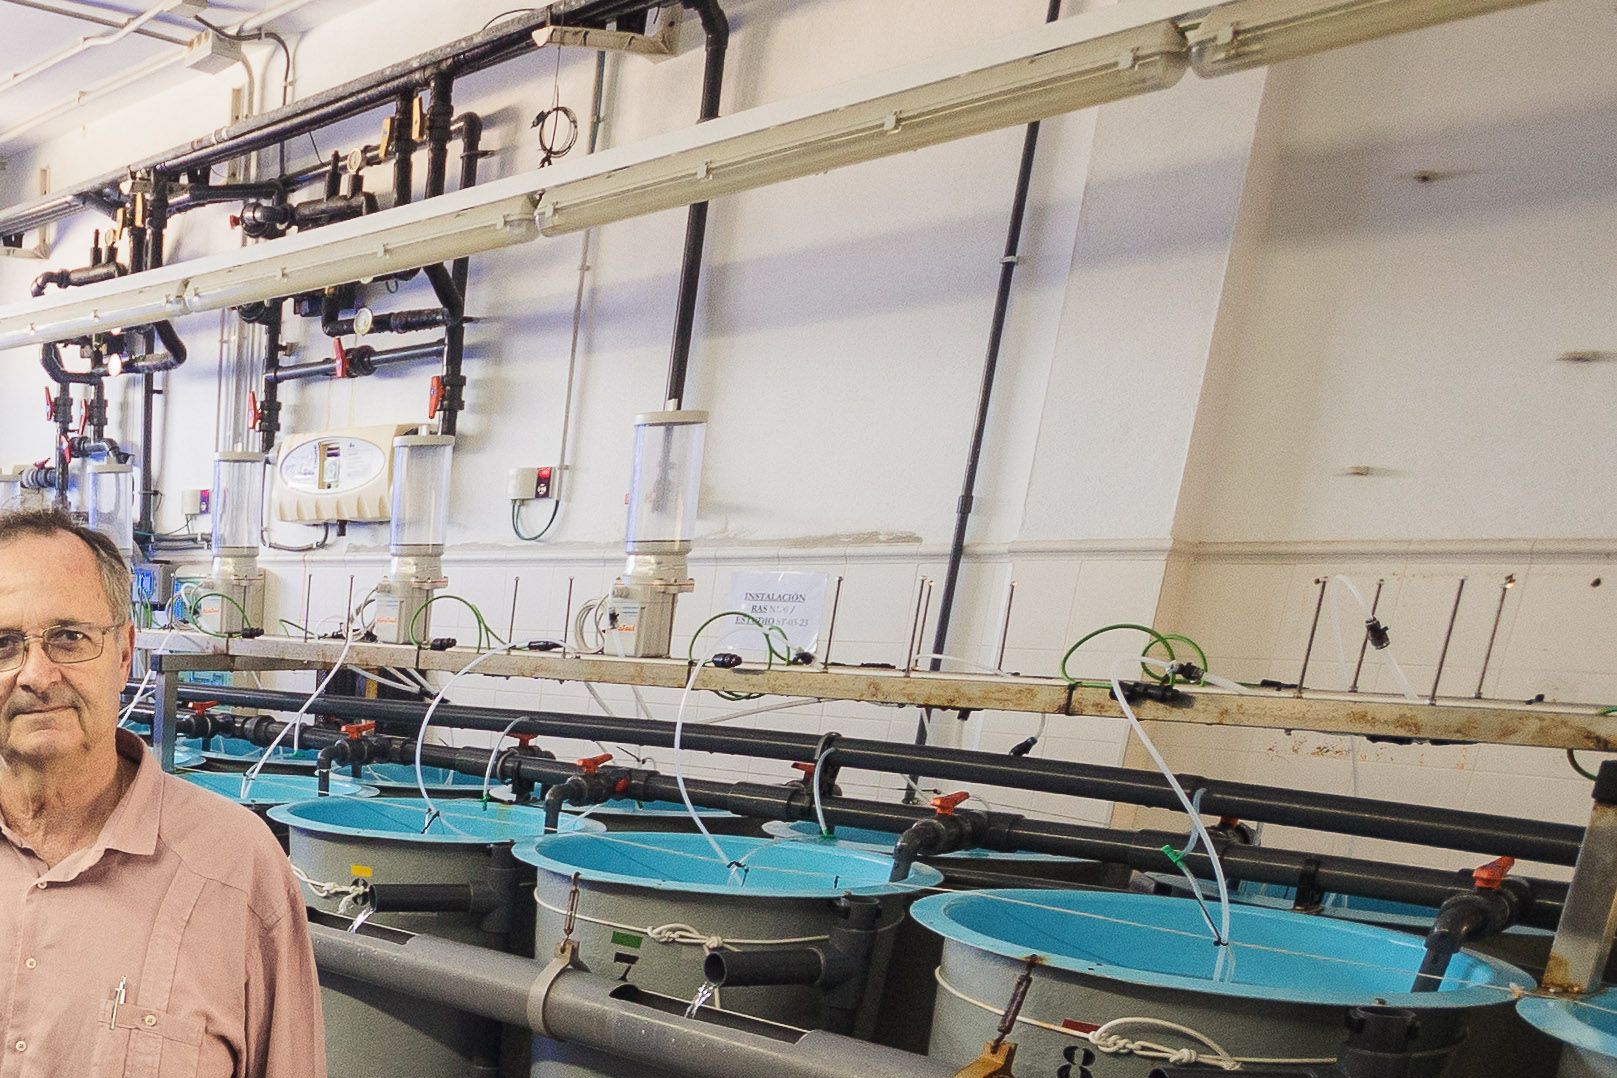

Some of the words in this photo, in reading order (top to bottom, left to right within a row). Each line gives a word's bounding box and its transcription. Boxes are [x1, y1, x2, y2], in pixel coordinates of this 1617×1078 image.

[744, 592, 806, 603] INSTALACIÓN
[751, 605, 768, 613] RAS
[614, 951, 640, 982] 7
